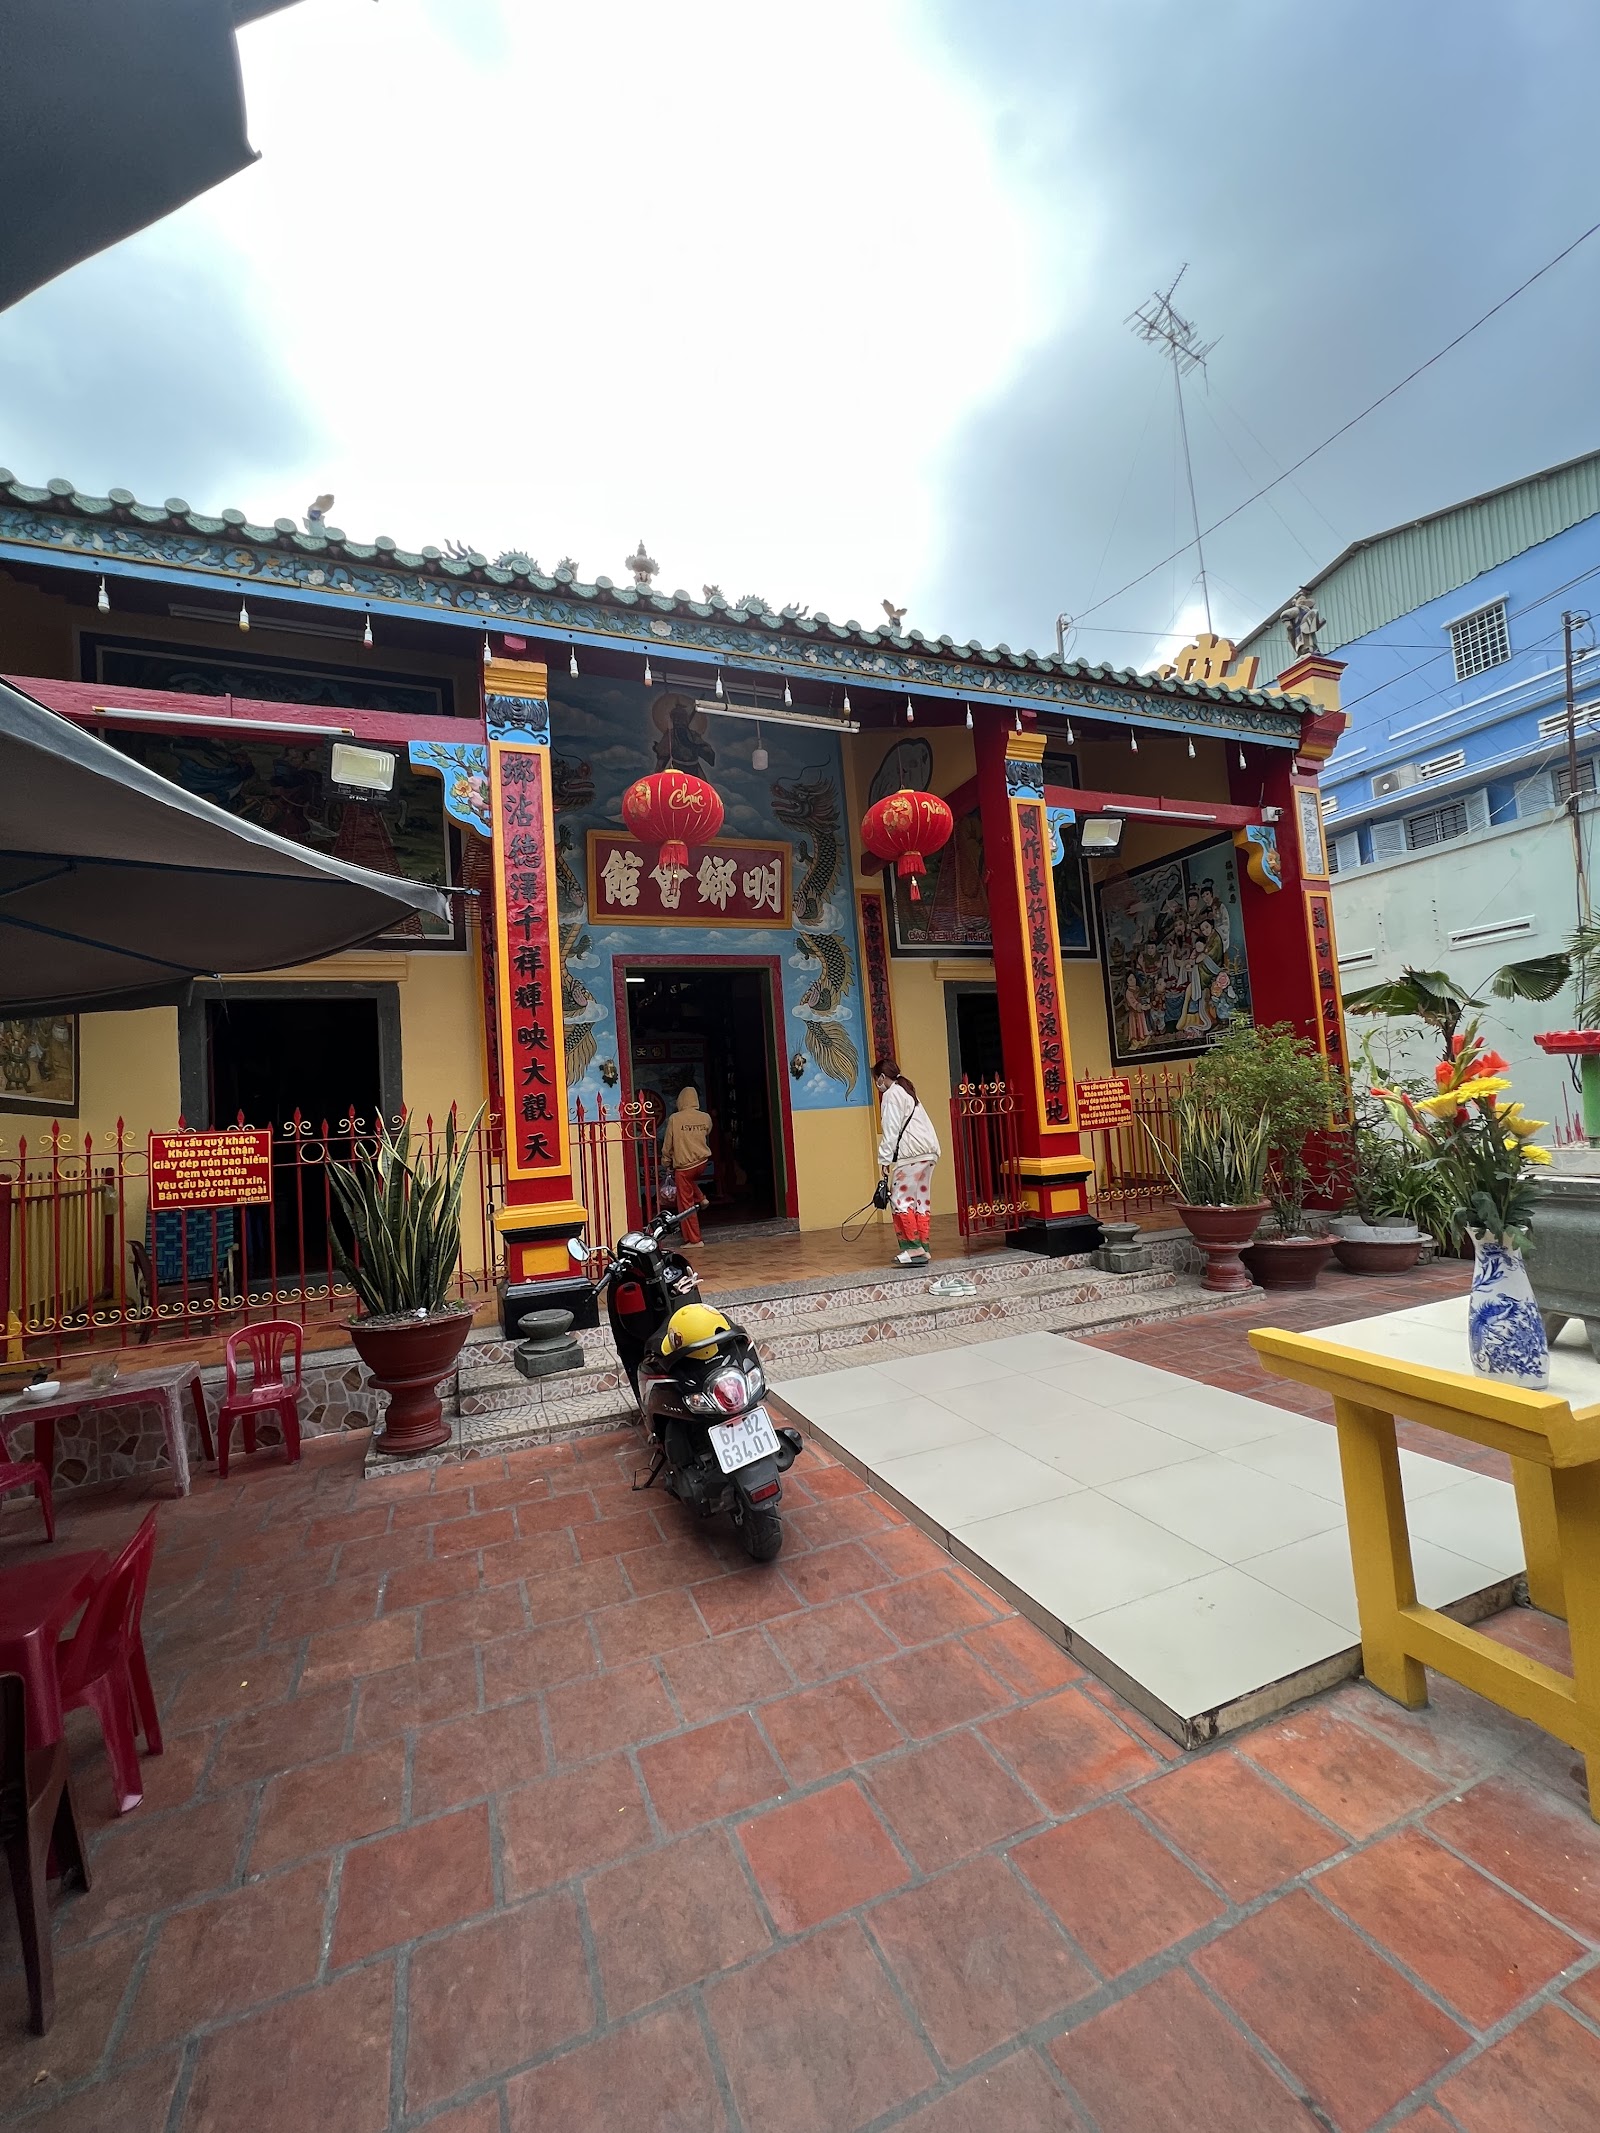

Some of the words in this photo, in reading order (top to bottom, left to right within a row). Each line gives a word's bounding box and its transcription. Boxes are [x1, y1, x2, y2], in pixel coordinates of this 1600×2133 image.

[668, 782, 706, 813] Chúc
[163, 1139, 182, 1148] Yêu
[204, 1137, 224, 1149] quý
[225, 1135, 260, 1145] khách.
[168, 1149, 196, 1158] Khóa
[197, 1149, 210, 1157] xe
[211, 1146, 230, 1156] cẩn
[231, 1146, 255, 1156] thận
[153, 1160, 178, 1170] Giày
[180, 1159, 199, 1169] dép
[200, 1158, 221, 1167] nón
[222, 1157, 241, 1166] bao
[242, 1154, 269, 1165] hiểm
[201, 1168, 222, 1177] vào
[223, 1167, 247, 1176] chùa
[157, 1181, 177, 1190] Yêu
[198, 1178, 211, 1187] bà
[212, 1179, 231, 1187] con
[232, 1177, 245, 1185] ăn
[159, 1191, 179, 1201] Bán
[181, 1190, 194, 1199] vé
[195, 1188, 208, 1199] số
[208, 1188, 217, 1197] ở
[217, 1187, 237, 1197] bên
[238, 1185, 267, 1196] ngoài
[722, 1431, 773, 1467] 634.01
